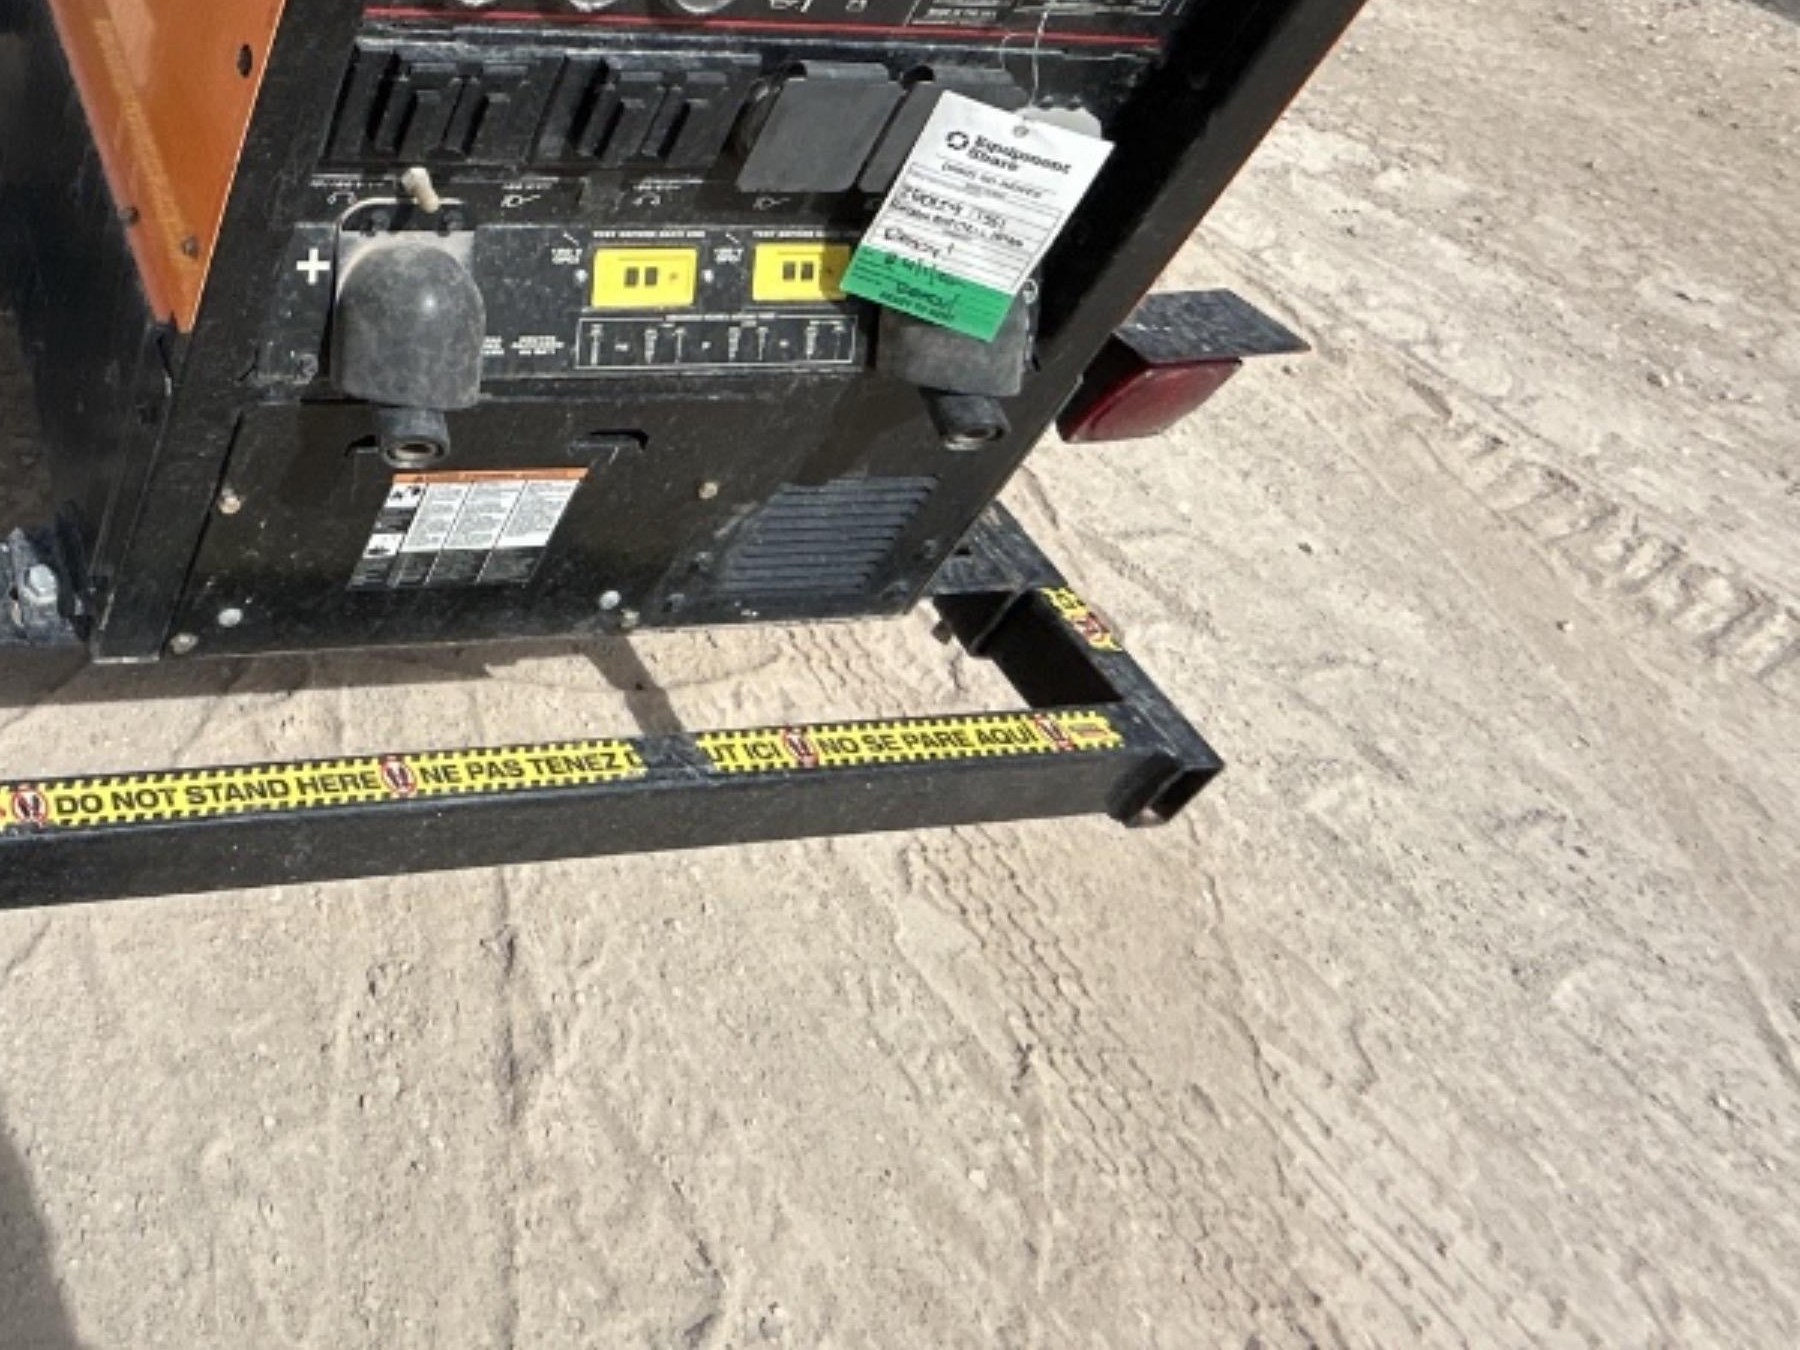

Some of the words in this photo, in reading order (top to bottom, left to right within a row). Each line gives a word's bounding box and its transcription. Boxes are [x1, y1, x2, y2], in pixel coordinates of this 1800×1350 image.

[973, 134, 1072, 175] Equipment
[55, 793, 103, 817] DO
[111, 787, 177, 812] NOT
[185, 777, 290, 805] STAND
[298, 770, 382, 796] HERE
[419, 764, 461, 784] NE
[467, 758, 524, 781] PAS
[526, 751, 622, 777] TENEZ
[746, 740, 781, 761] ICI
[817, 735, 860, 756] NO
[864, 731, 900, 753] SE
[906, 726, 970, 751] PARE
